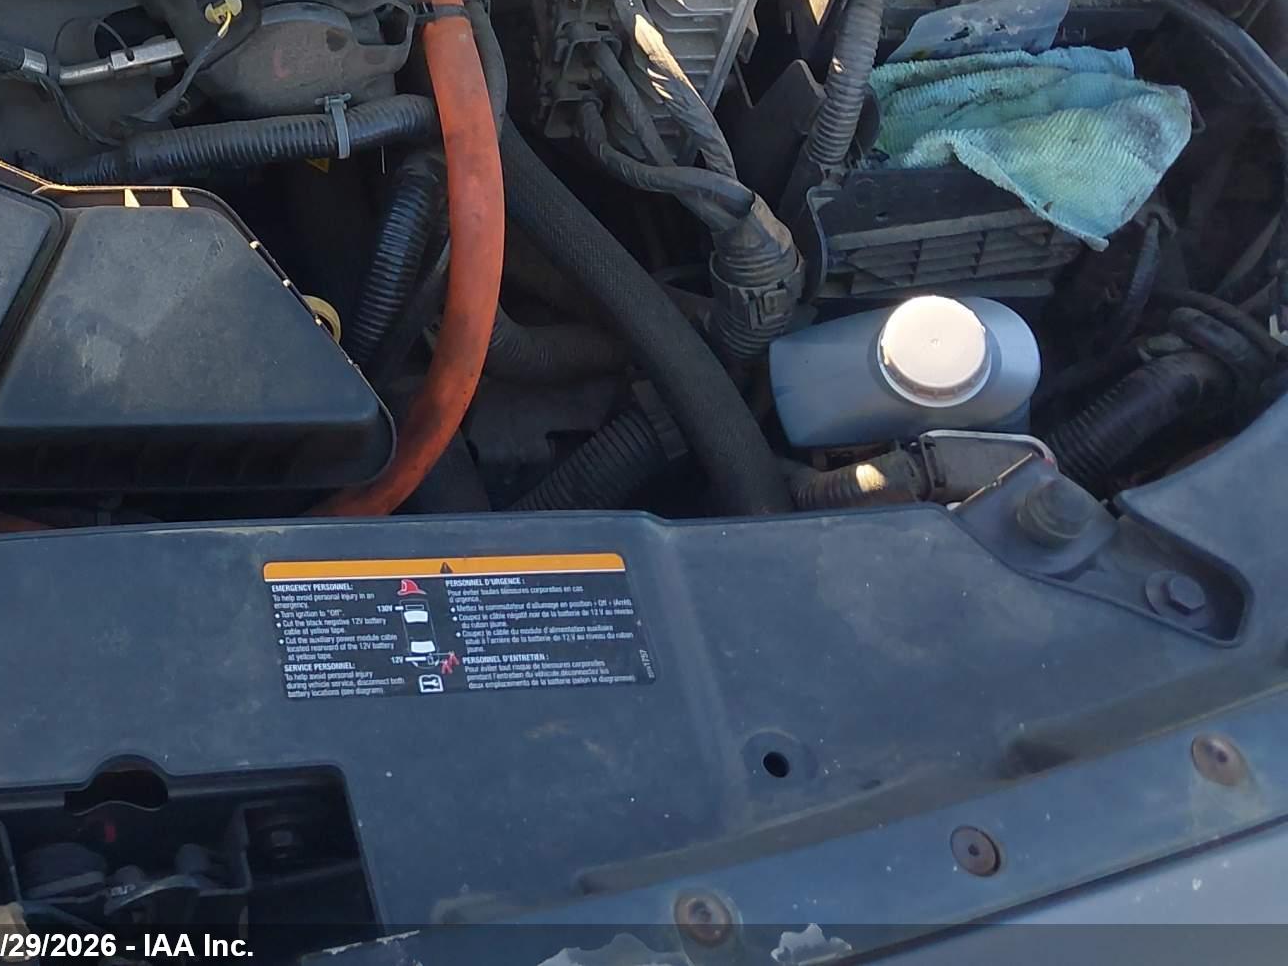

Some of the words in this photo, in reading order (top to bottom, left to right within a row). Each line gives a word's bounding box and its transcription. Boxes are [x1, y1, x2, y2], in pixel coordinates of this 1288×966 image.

[445, 579, 483, 587] PERSONNEL
[272, 585, 311, 593] EMERGENCY
[313, 583, 353, 591] PERSONNEL:
[463, 656, 501, 664] PERSONNEL
[284, 664, 312, 672] SERVICE
[314, 662, 355, 670] PERSONNEL:
